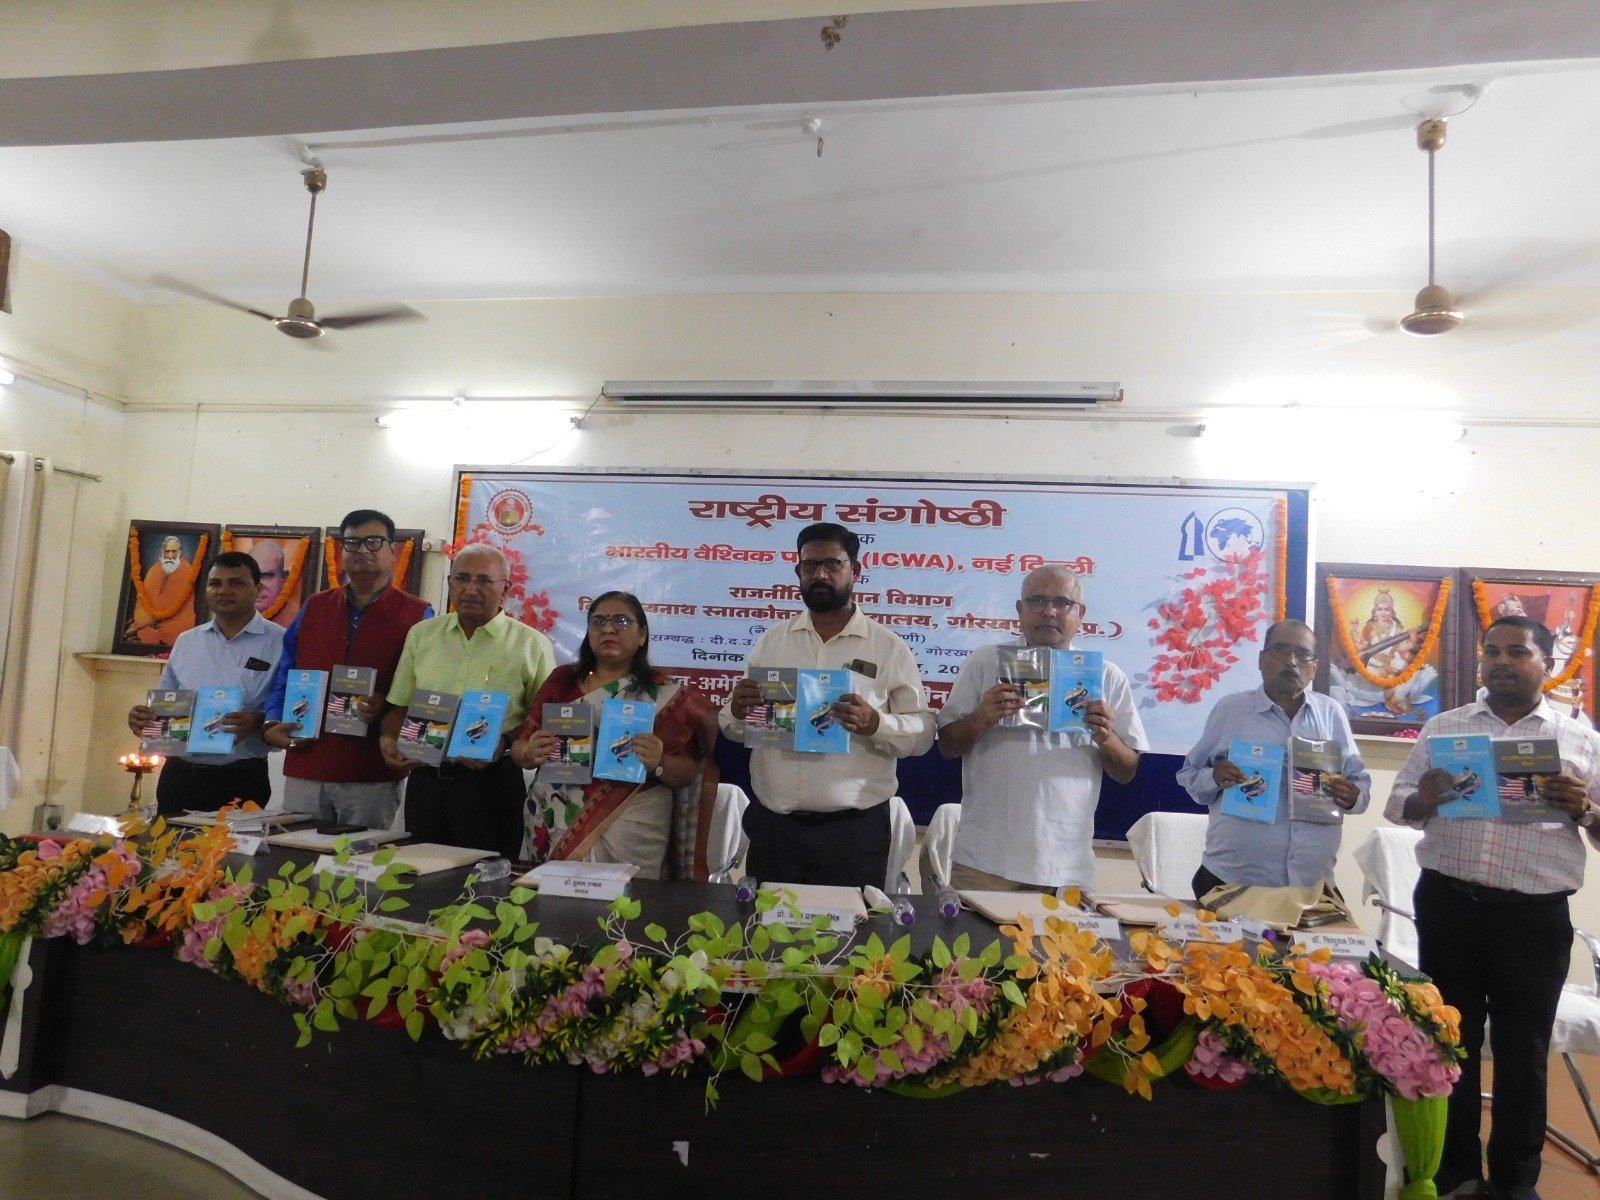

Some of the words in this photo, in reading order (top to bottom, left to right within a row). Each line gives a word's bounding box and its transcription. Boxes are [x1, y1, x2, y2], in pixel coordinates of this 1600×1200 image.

[688, 494, 827, 529] राष्ट्रीय
[835, 497, 1007, 527] संगोष्ठी
[606, 542, 690, 561] भारतीय
[694, 544, 776, 563] वैश्विक
[862, 551, 965, 573] (ICWA),
[972, 553, 1015, 574] नई
[886, 589, 954, 607] विभाग
[692, 648, 744, 662] दिनांक
[937, 664, 960, 675] 20
